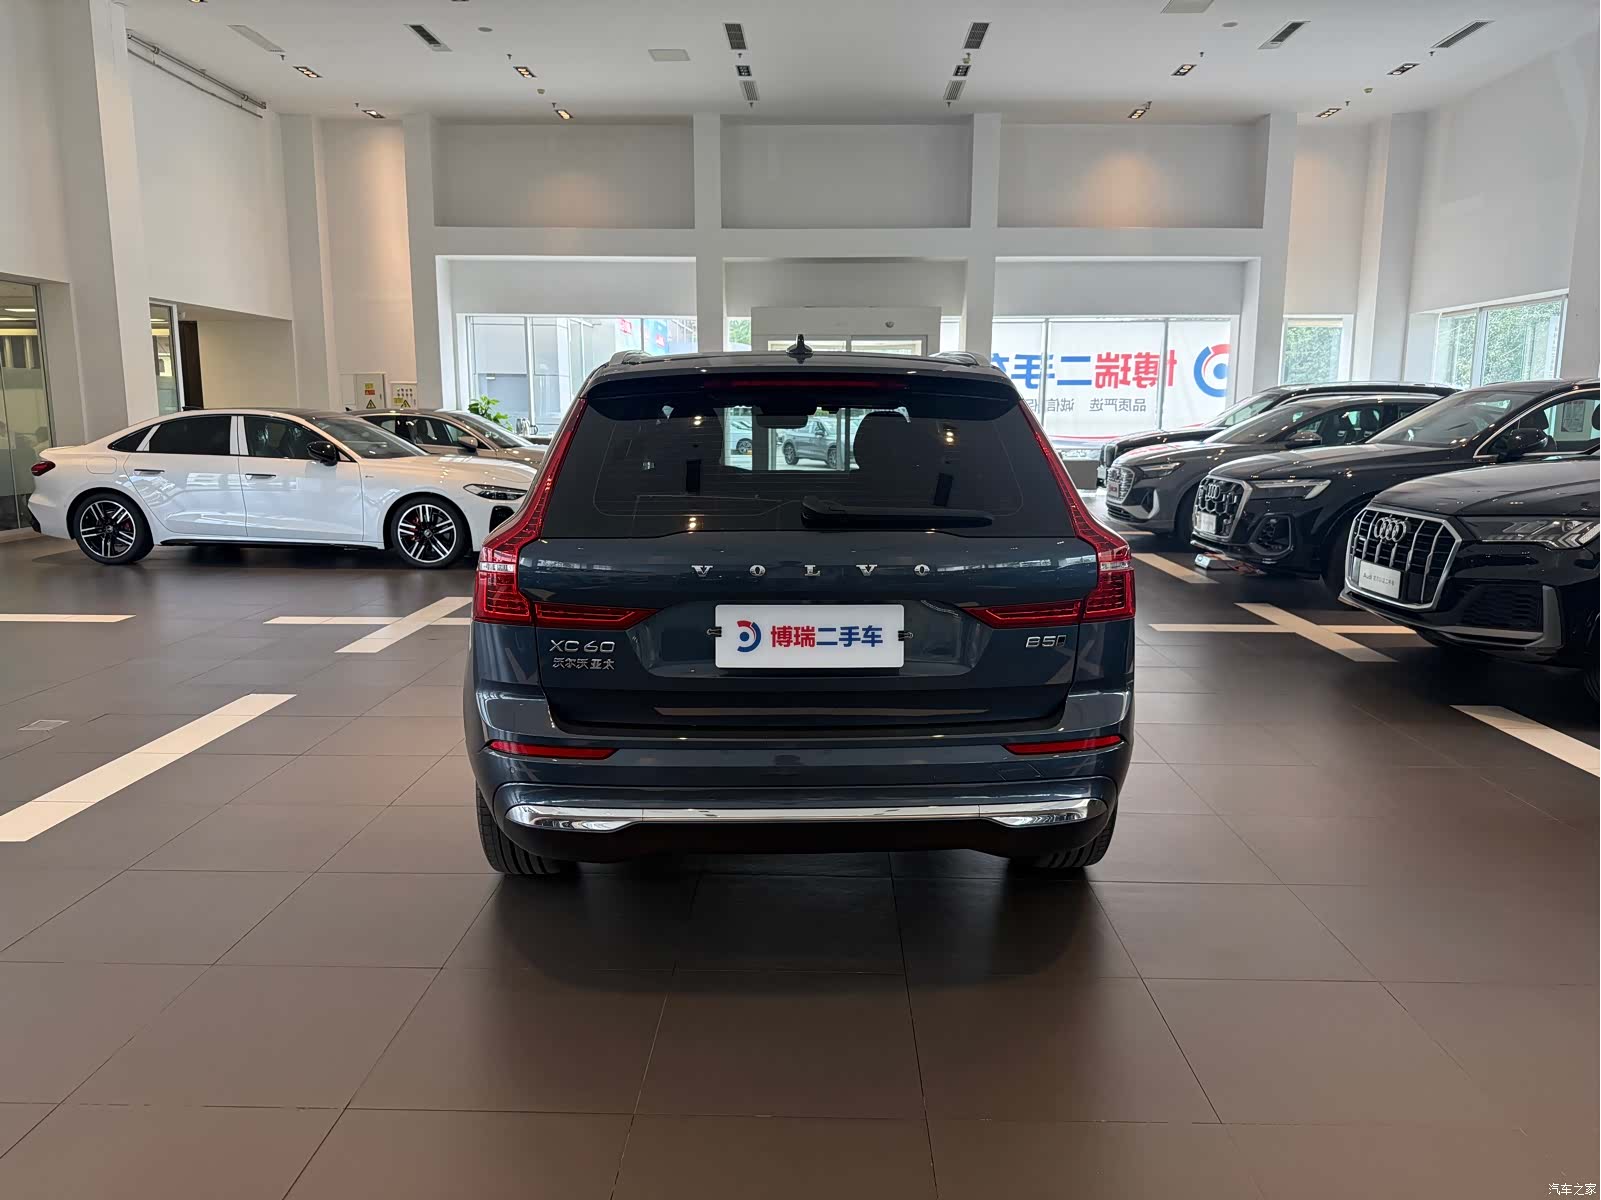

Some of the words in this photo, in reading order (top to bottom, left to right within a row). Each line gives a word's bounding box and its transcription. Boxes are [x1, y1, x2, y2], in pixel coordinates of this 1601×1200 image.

[691, 564, 931, 577] VOLVO
[770, 625, 884, 648] 博瑞二手车
[552, 657, 615, 670] 沃尔沃亚太
